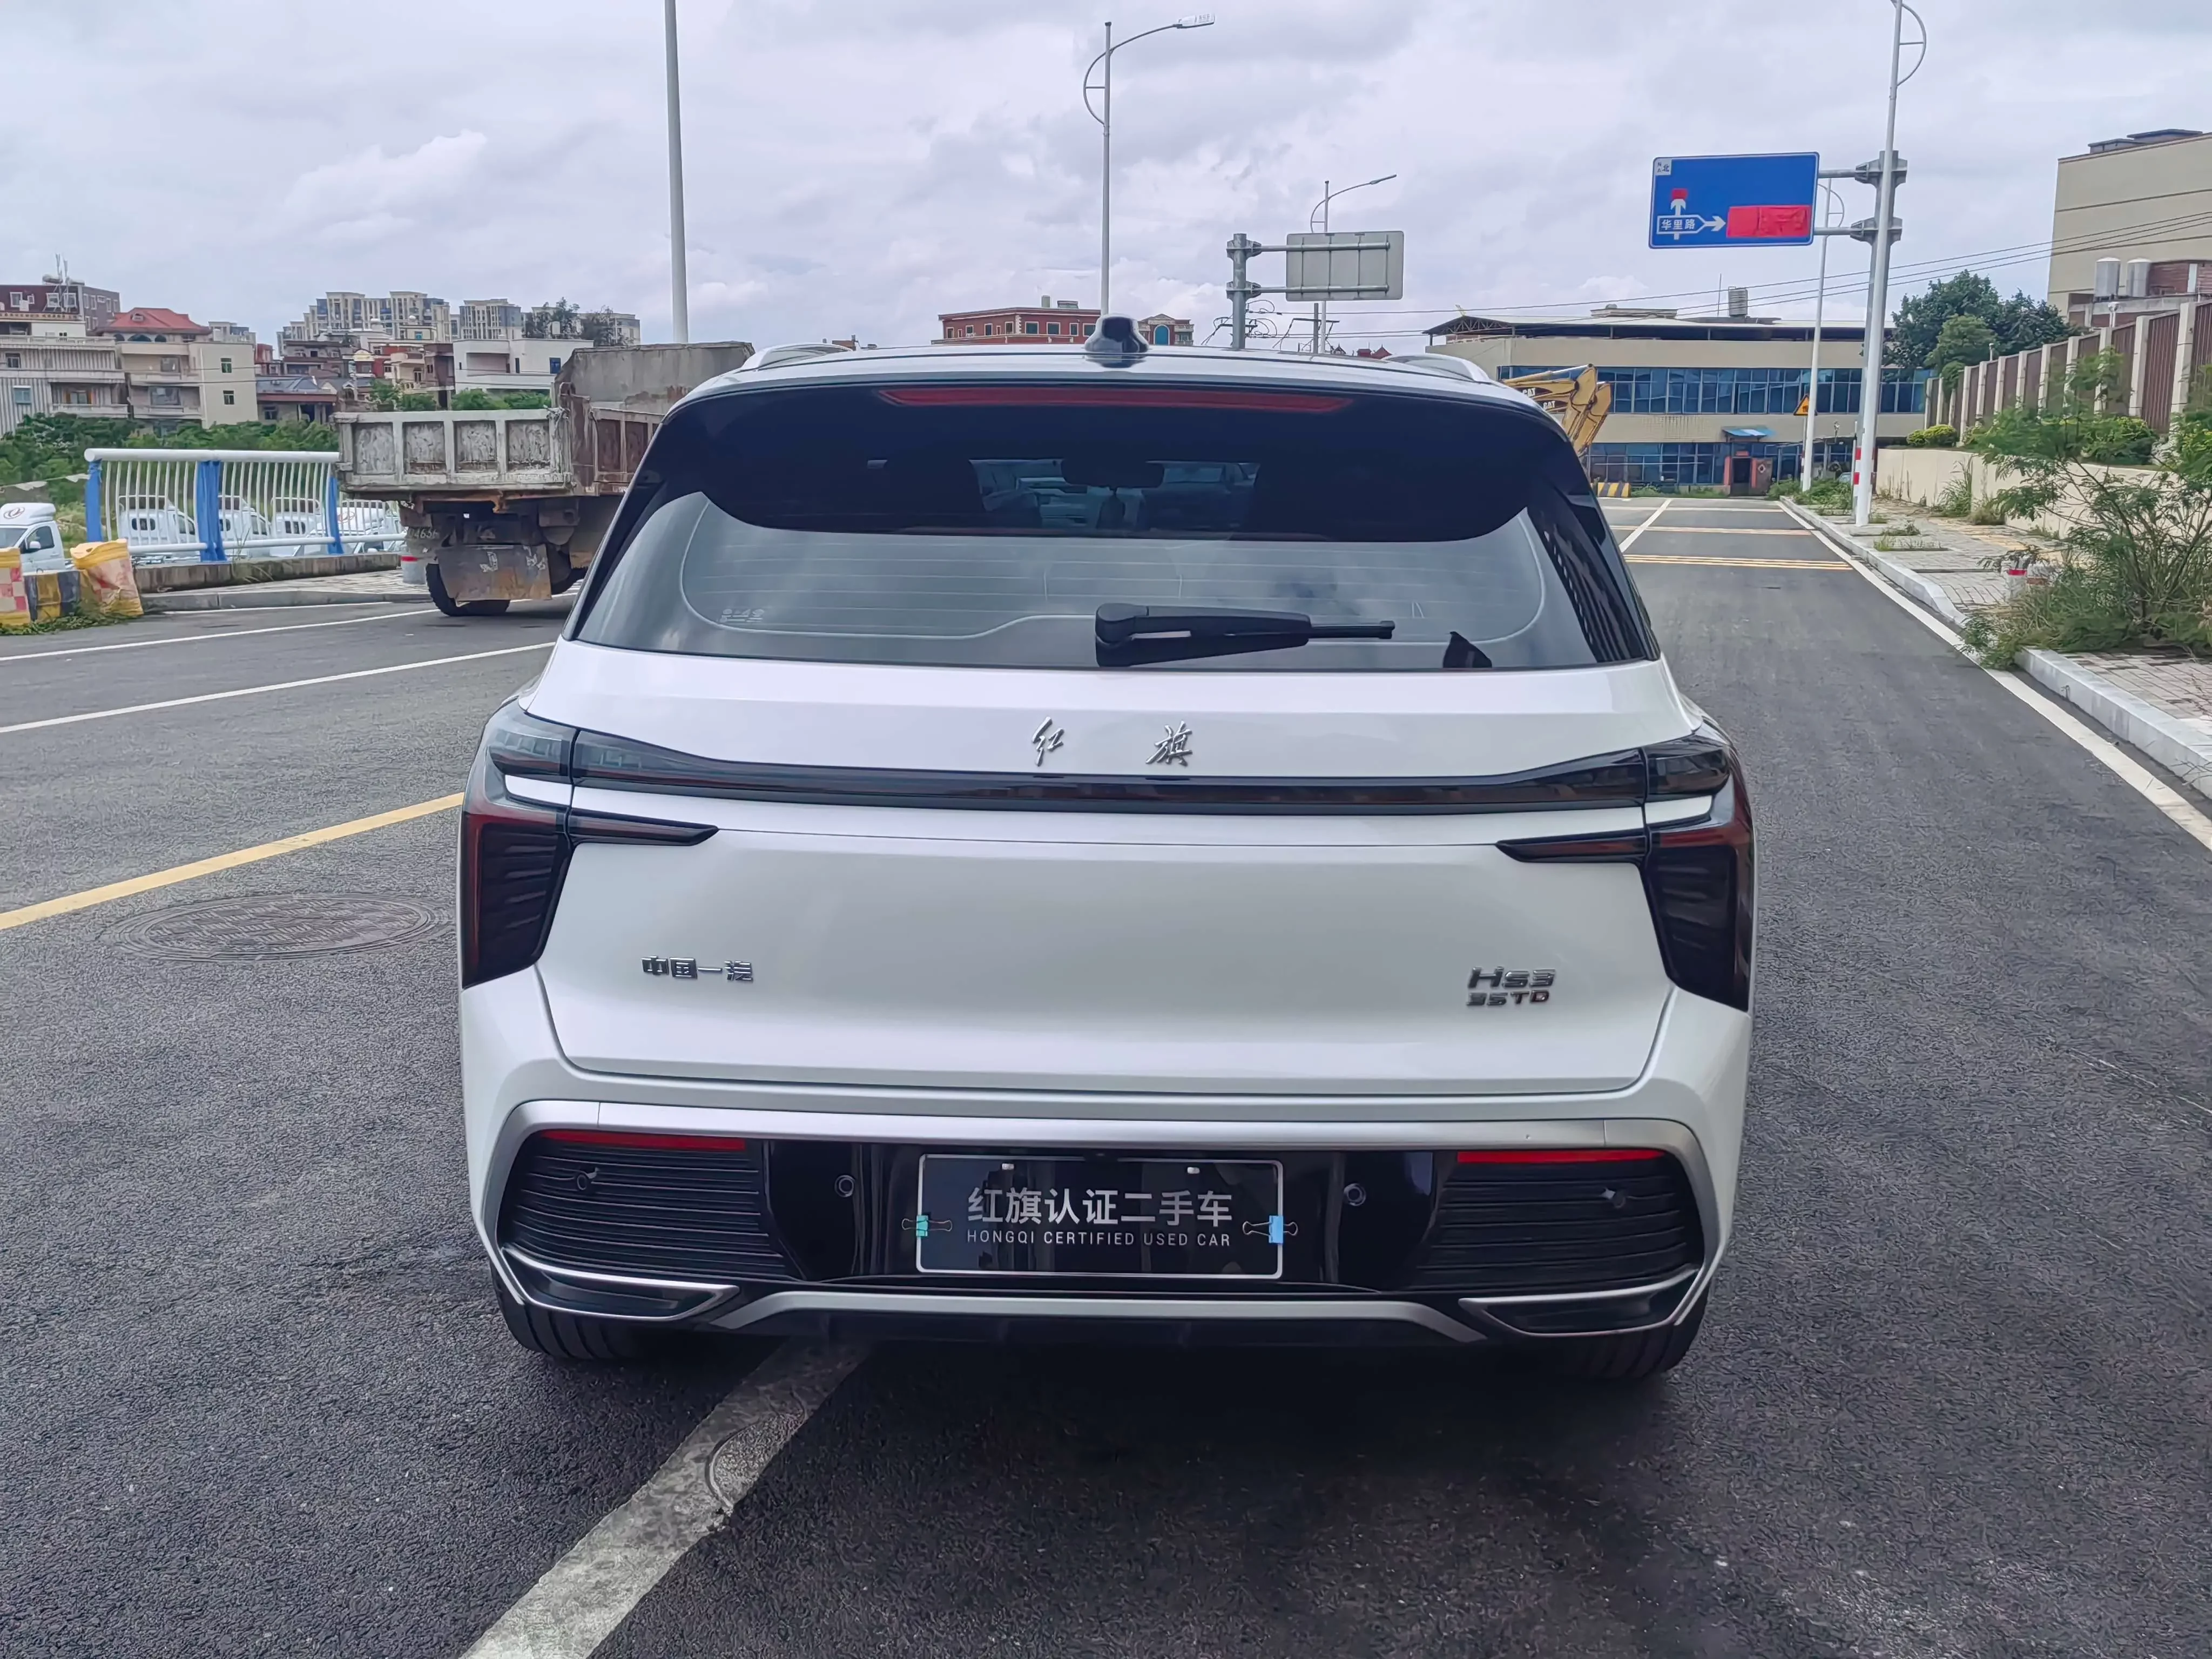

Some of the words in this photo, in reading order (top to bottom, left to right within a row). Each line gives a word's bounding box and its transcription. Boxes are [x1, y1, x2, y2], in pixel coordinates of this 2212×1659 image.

[1662, 164, 1670, 172] 北
[1522, 388, 1536, 397] CAT
[1543, 400, 1555, 410] CAT
[1032, 716, 1192, 767] 红旗
[641, 955, 754, 982] 中国一汽
[1467, 966, 1556, 988] HS3
[968, 1187, 1233, 1227] 红旗认证二手车
[967, 1229, 1034, 1244] HONGQI
[1043, 1231, 1135, 1245] CERTIFIED
[1143, 1232, 1188, 1246] USED
[1197, 1233, 1230, 1246] CAR
